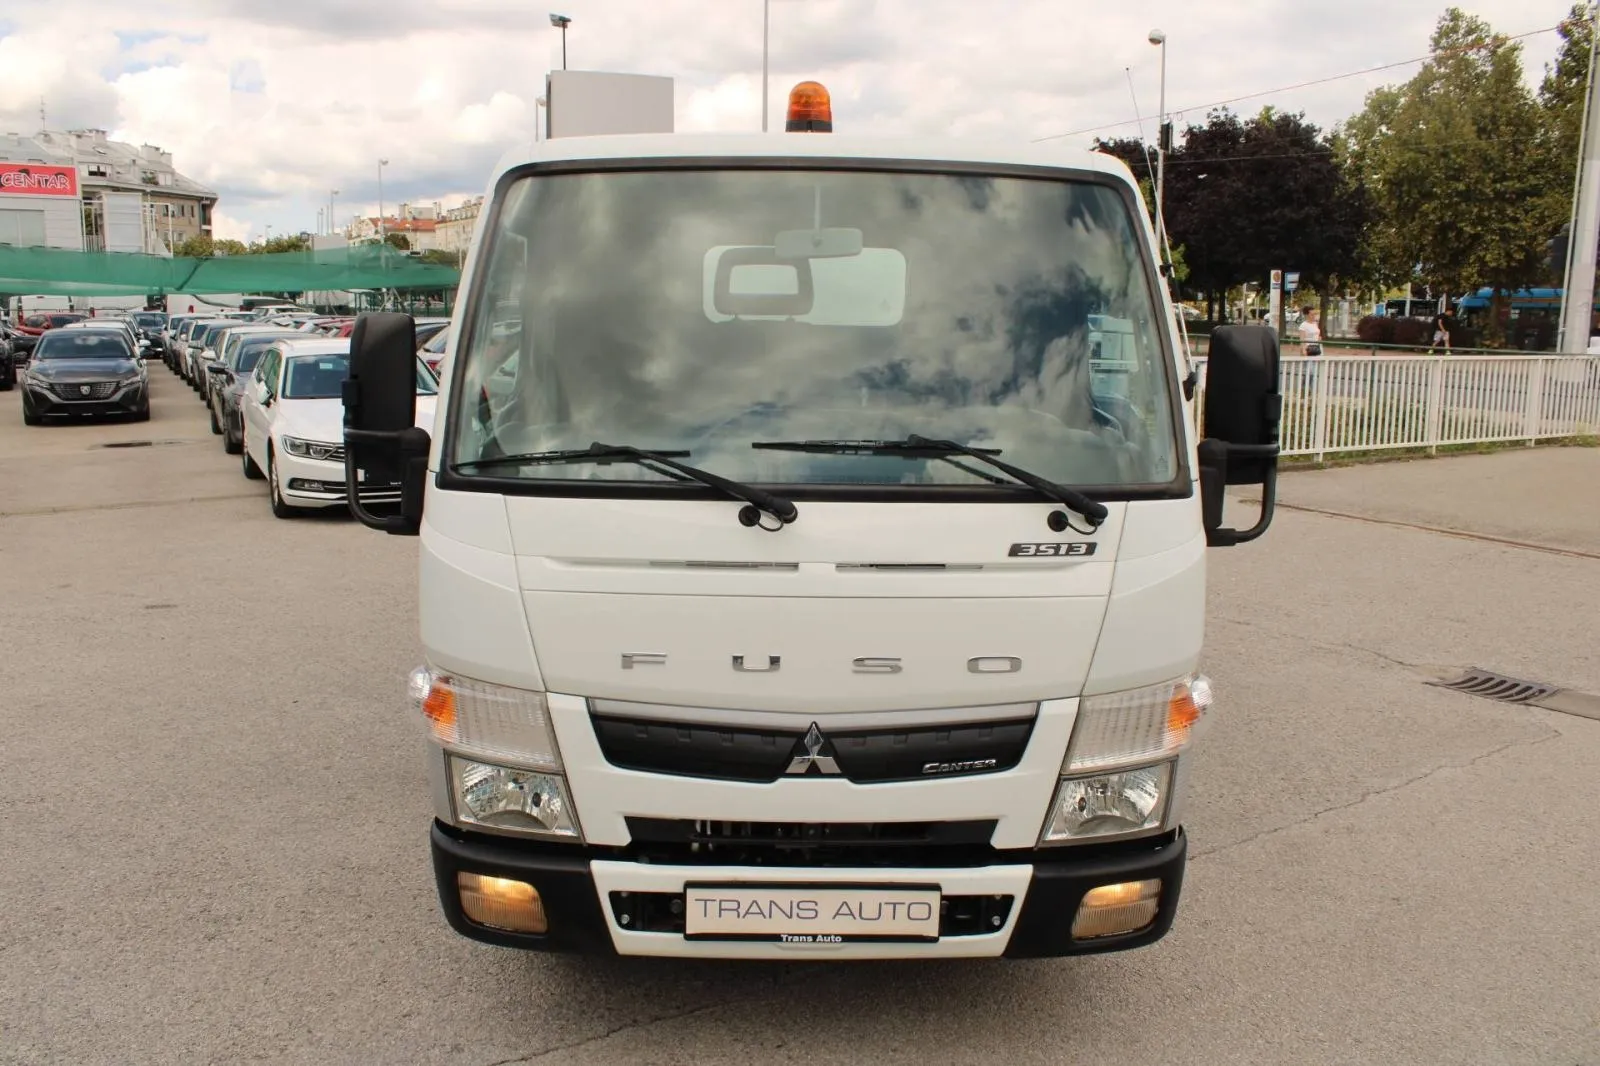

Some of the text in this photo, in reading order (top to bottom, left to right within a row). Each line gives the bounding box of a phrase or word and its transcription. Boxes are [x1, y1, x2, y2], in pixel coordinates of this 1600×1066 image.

[1, 172, 70, 189] CENTAR
[621, 651, 1023, 674] FUSO
[694, 898, 932, 921] TRANS AUTO
[781, 934, 842, 943] Trans Auto
